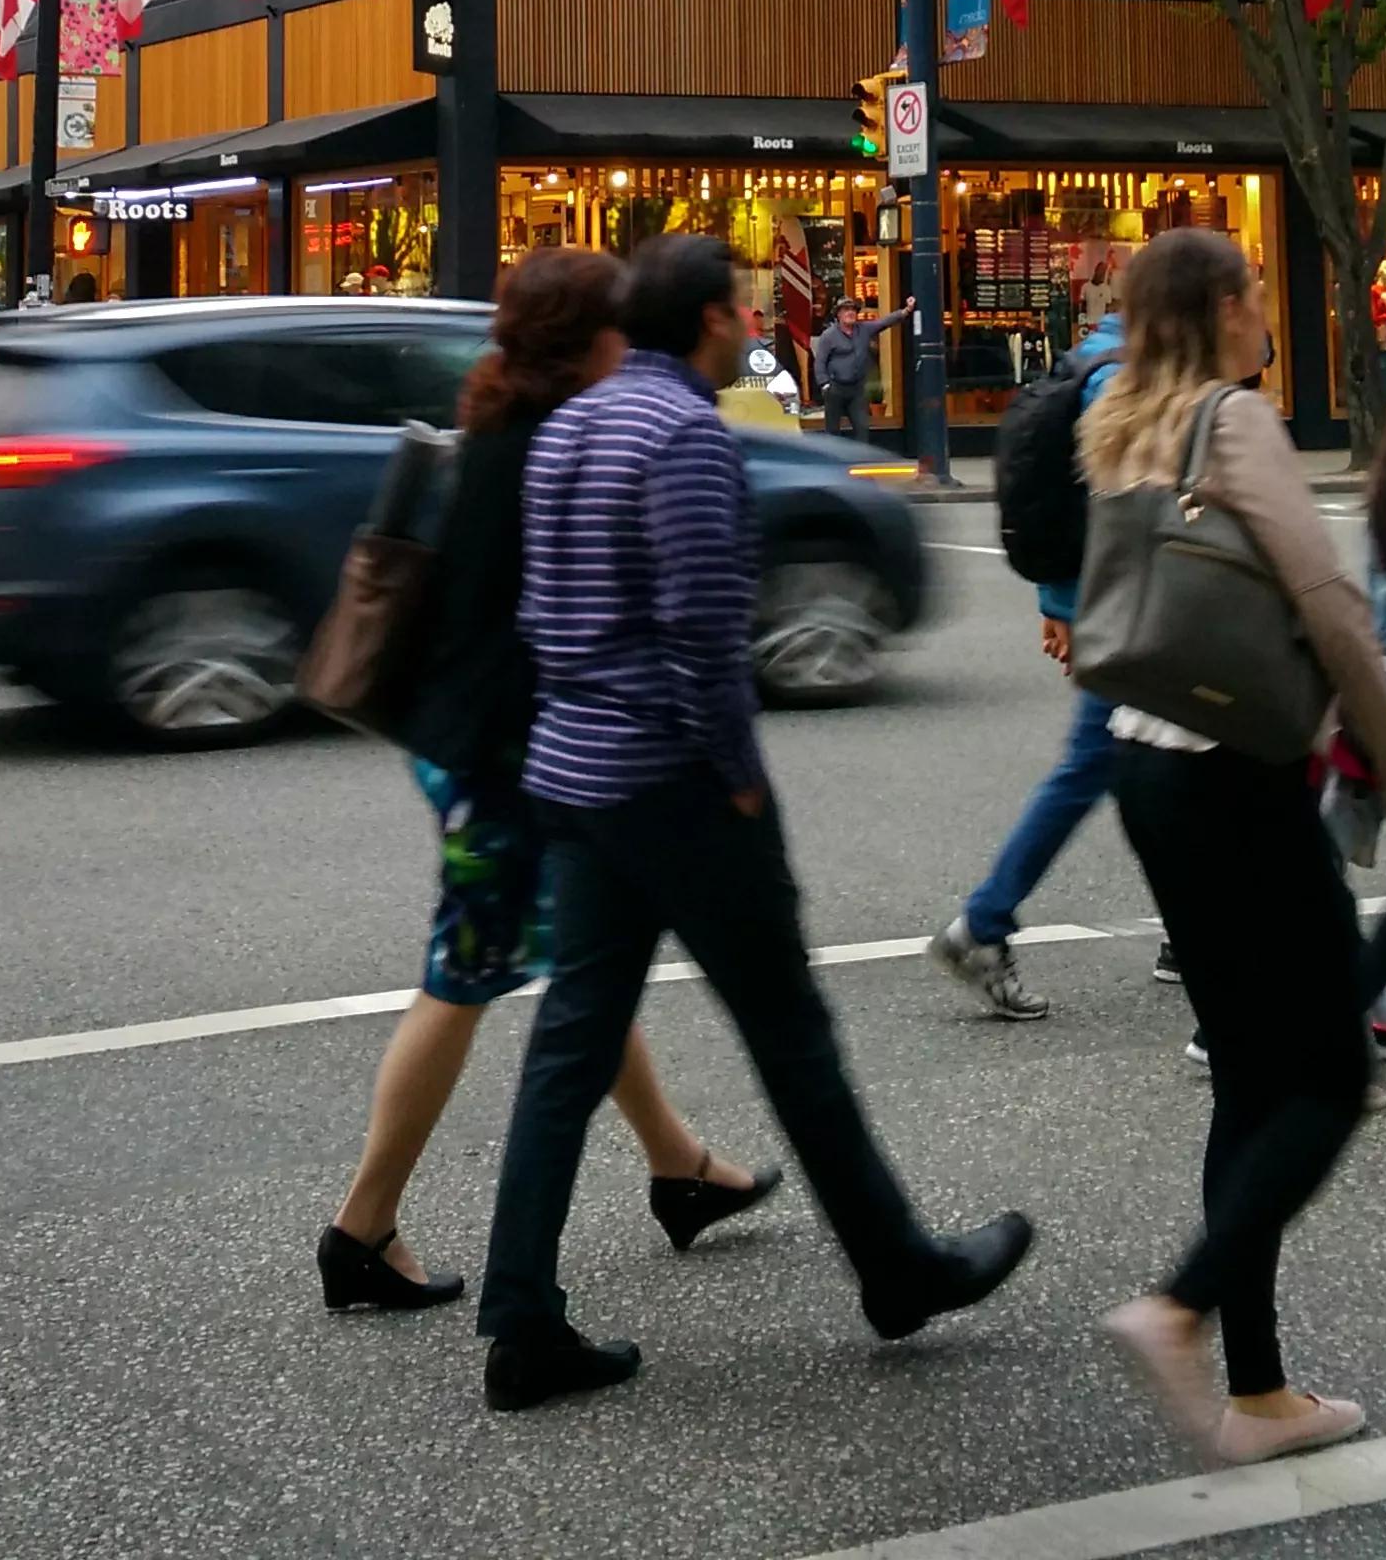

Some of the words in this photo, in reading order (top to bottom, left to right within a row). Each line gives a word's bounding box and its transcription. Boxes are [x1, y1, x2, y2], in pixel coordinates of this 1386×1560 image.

[753, 135, 794, 149] Roots
[896, 143, 921, 154] EXCEPT
[1176, 140, 1213, 154] Roots
[108, 199, 188, 220] Roots
